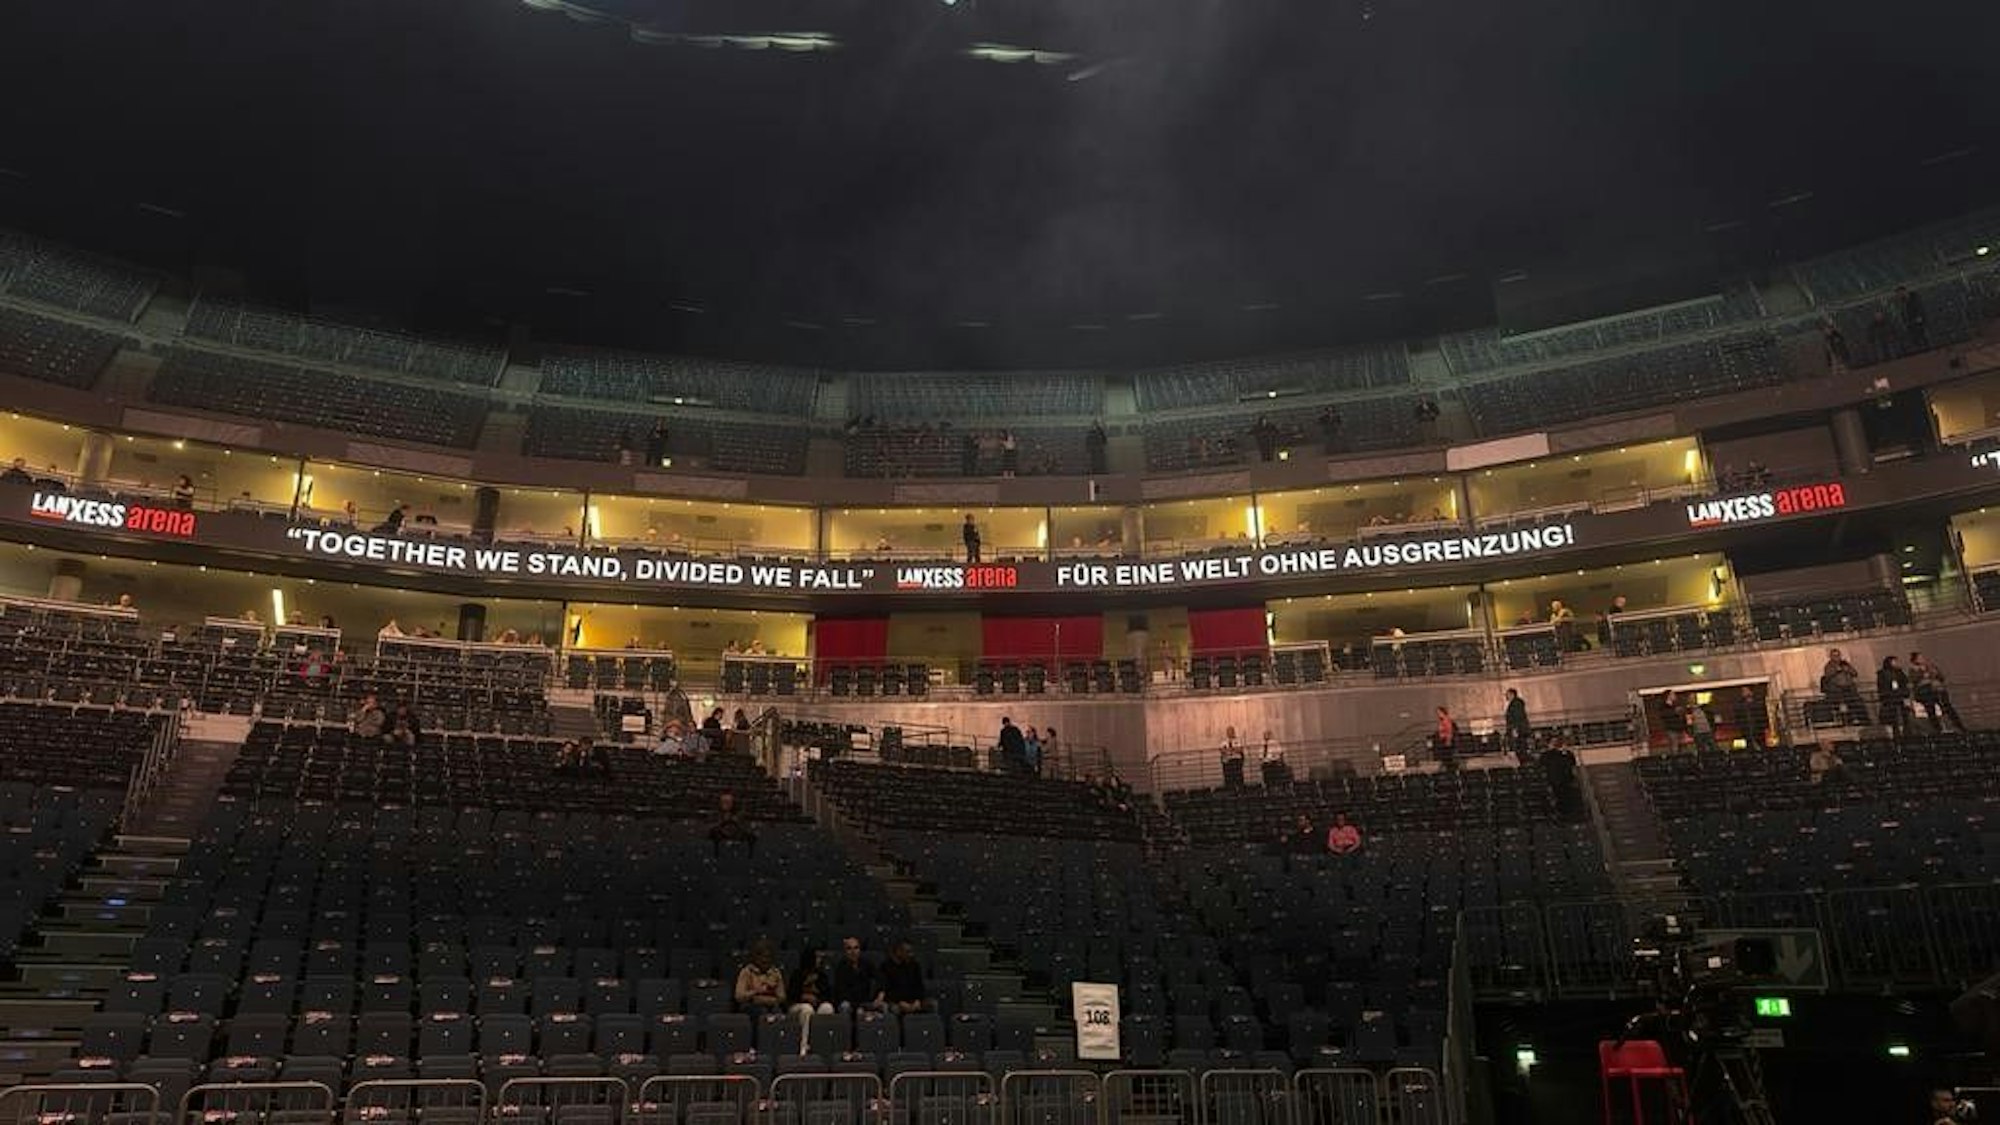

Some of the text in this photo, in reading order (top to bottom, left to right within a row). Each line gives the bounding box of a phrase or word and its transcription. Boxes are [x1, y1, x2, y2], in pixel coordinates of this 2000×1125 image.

[31, 492, 196, 536] LANXESS arena
[1686, 483, 1845, 526] LANXESS arena
[474, 549, 520, 572] WE
[527, 553, 627, 581] STAND,
[635, 559, 744, 584] DIVIDED
[750, 565, 792, 587] WE
[1057, 524, 1575, 586] FÜR EINE WELT OHNE AUSGRENZUNG!
[897, 566, 1017, 589] LANXESS arena
